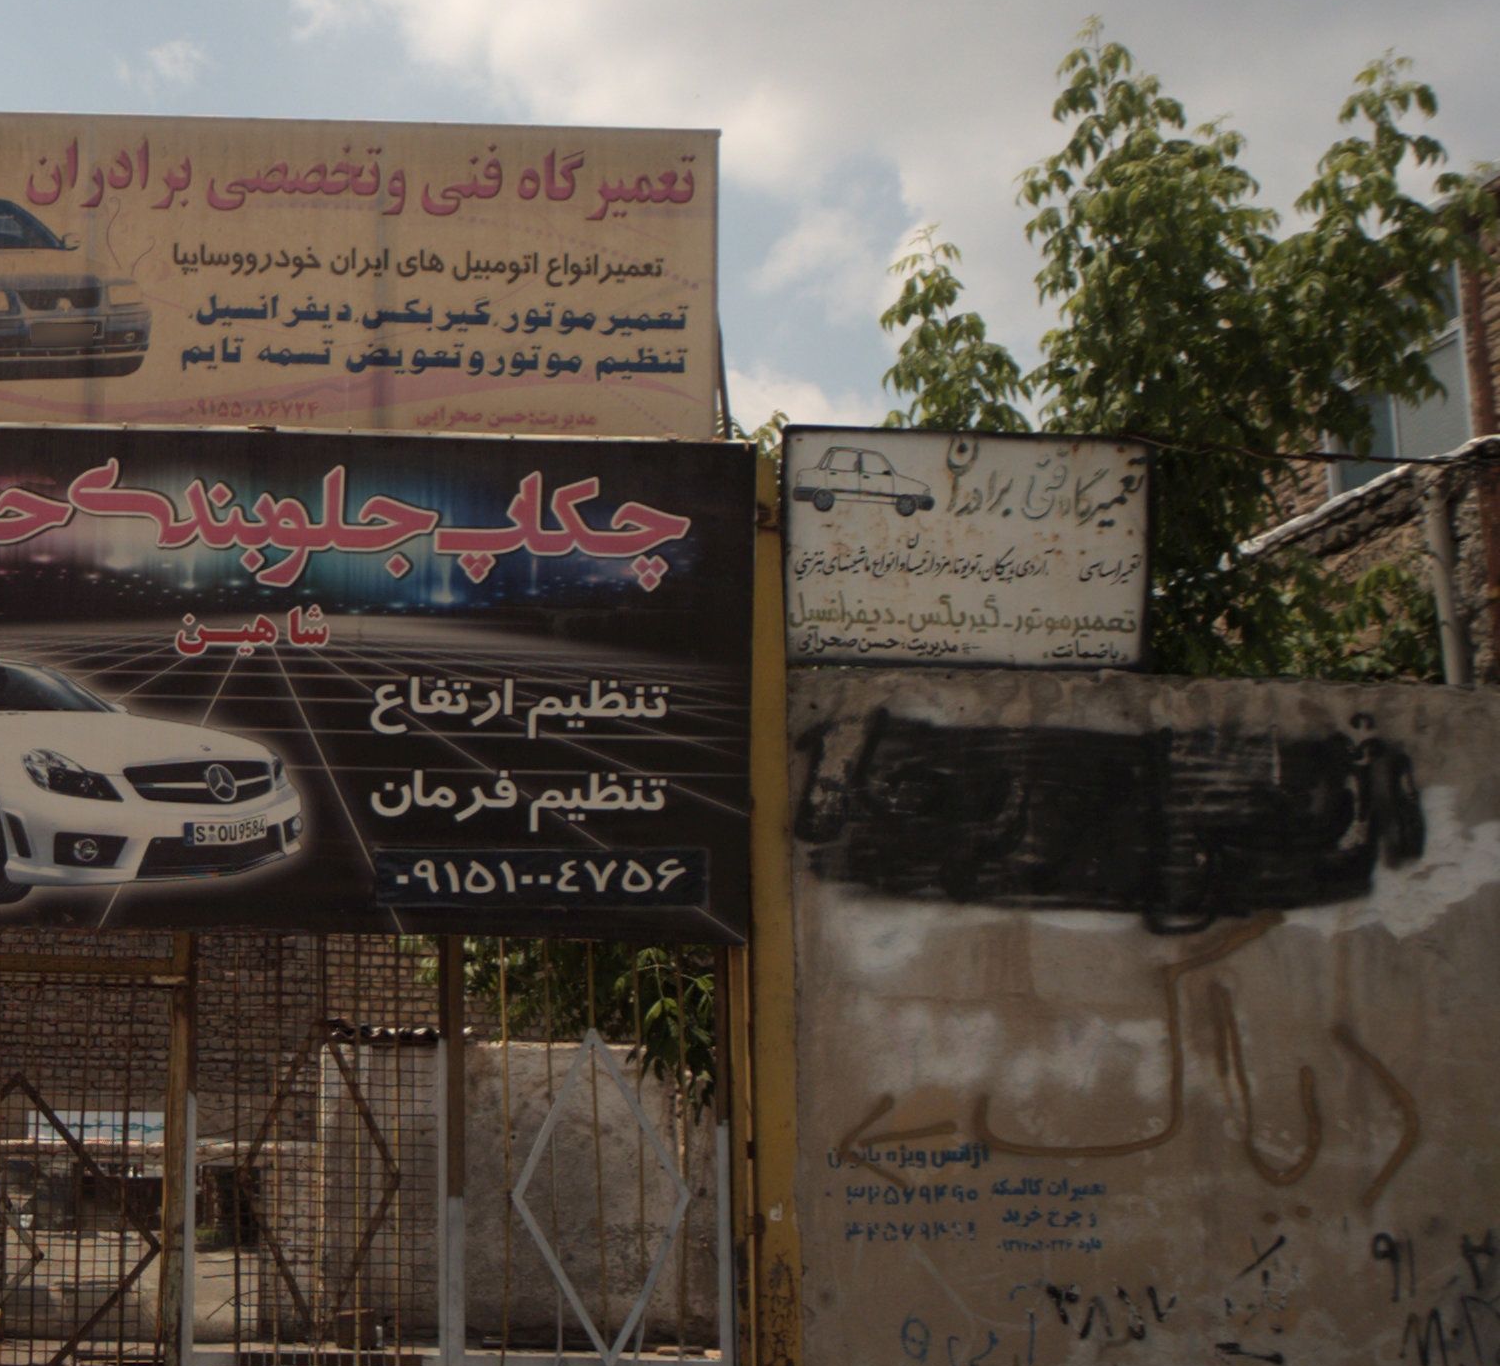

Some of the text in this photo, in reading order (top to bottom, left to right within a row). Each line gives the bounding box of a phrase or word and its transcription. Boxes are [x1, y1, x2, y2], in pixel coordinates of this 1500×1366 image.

[26, 135, 192, 210] برادران
[422, 143, 503, 215] فنی
[330, 247, 389, 276] ایران
[396, 249, 445, 276] های
[453, 250, 538, 284] اتومبیل
[600, 305, 688, 337] تعمیر
[181, 335, 246, 372] تایم
[257, 340, 334, 367] تسمه
[488, 345, 582, 378] موتور
[596, 346, 688, 381] تنظیم
[67, 457, 440, 588] جلوبندی
[432, 470, 691, 592] چکاپ
[858, 635, 900, 653] حسن
[370, 675, 670, 739] تنظیم ارتفاع
[370, 768, 668, 833] تنظیم فرمان
